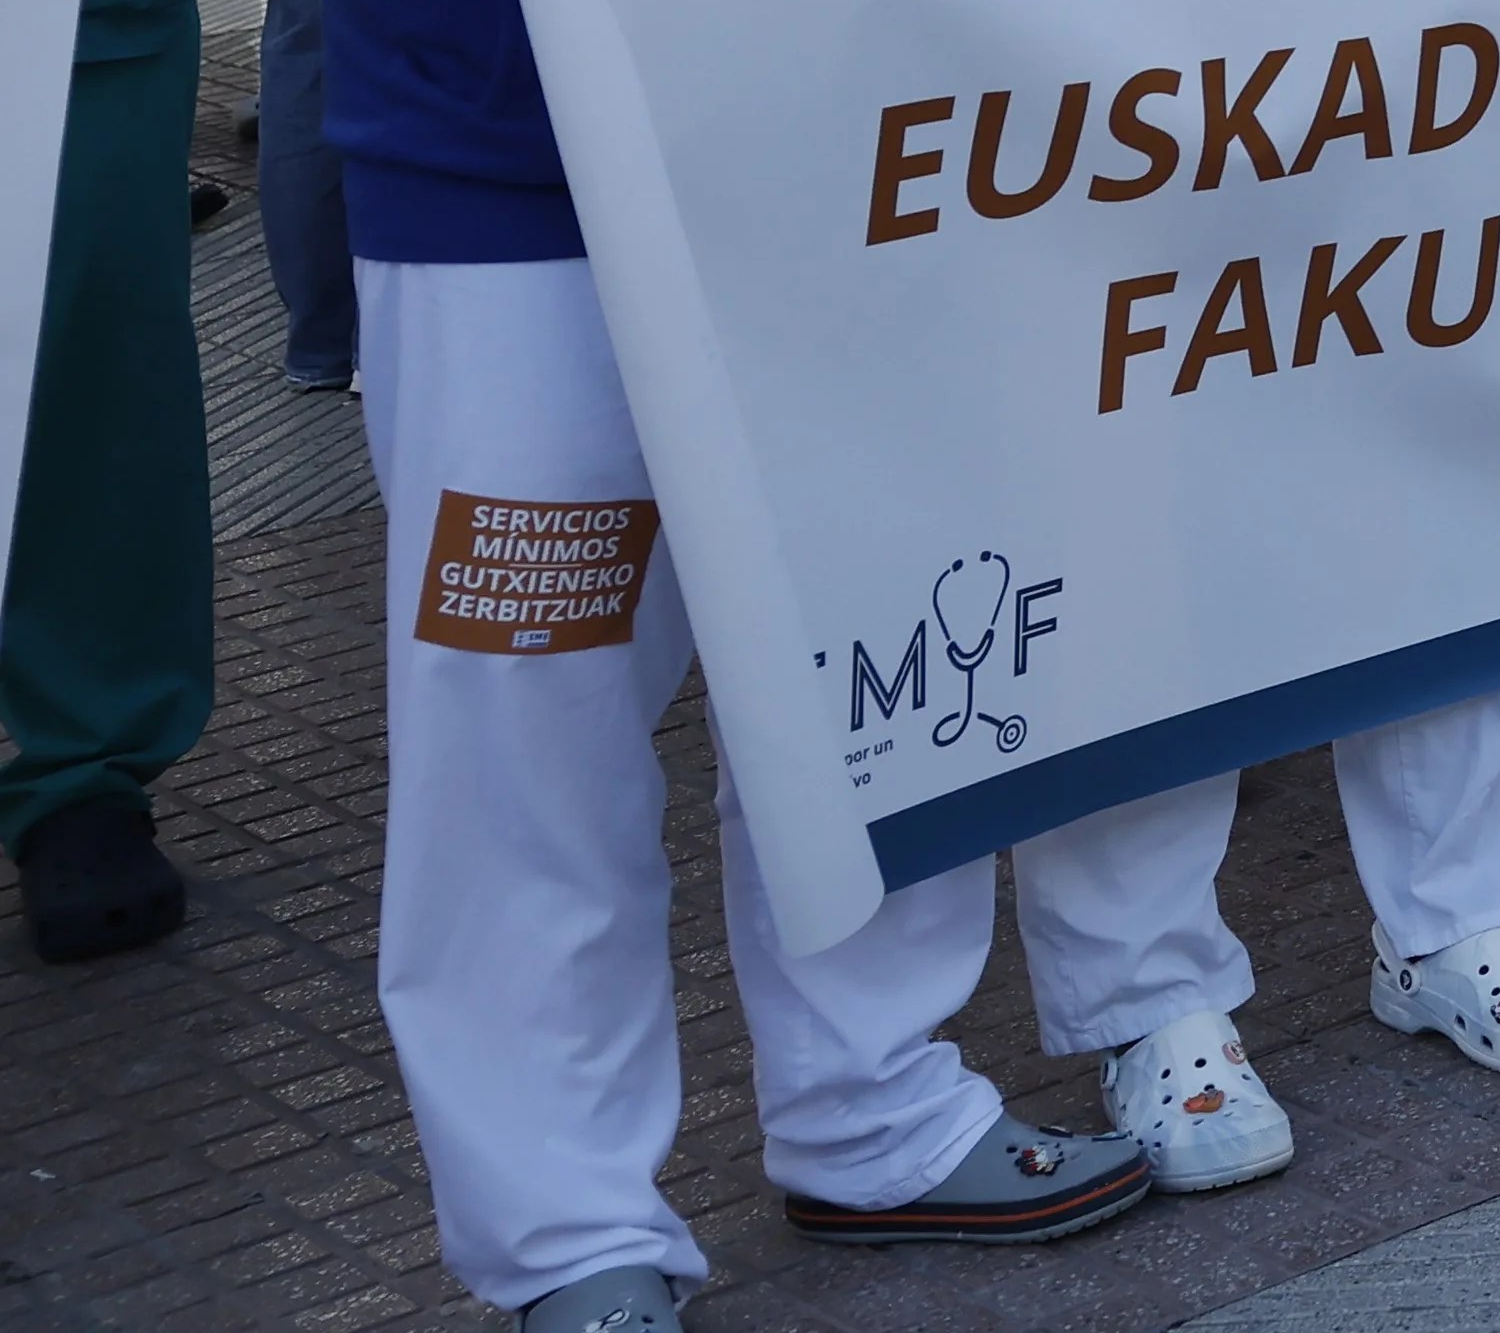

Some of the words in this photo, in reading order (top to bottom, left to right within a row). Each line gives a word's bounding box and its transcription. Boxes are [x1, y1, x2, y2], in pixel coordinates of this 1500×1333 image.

[471, 504, 632, 534] SERVICIOS
[472, 532, 621, 563] MÍNIMOS
[440, 561, 635, 595] GUTXIENEKO
[438, 590, 626, 623] ZERBITZUAK
[873, 739, 894, 757] un
